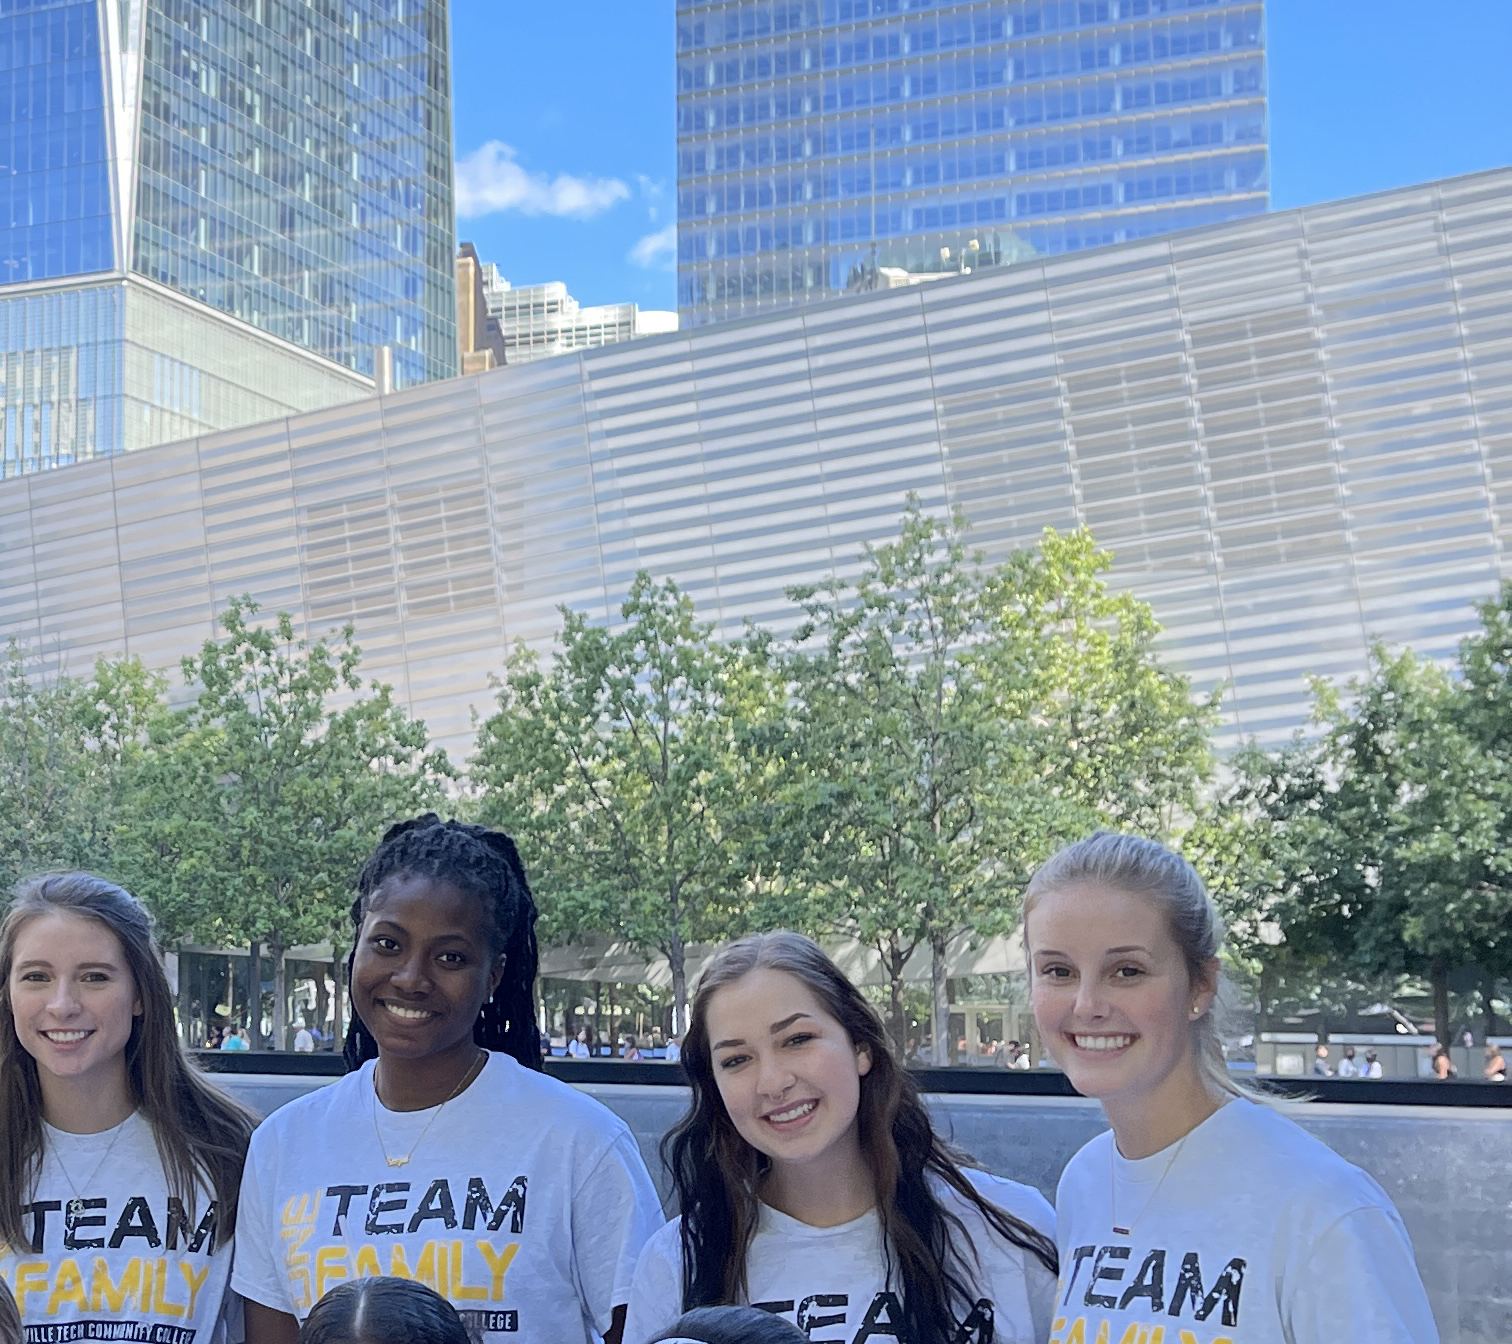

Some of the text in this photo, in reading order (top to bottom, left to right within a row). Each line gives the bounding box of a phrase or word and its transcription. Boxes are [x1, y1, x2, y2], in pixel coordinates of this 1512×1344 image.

[20, 1196, 219, 1256] TEAM
[325, 1175, 528, 1236] TEAM
[15, 1256, 210, 1320] FAMILY
[315, 1239, 521, 1302] FAMILY
[1064, 1244, 1247, 1328] TEAM
[56, 1323, 85, 1342] TECH
